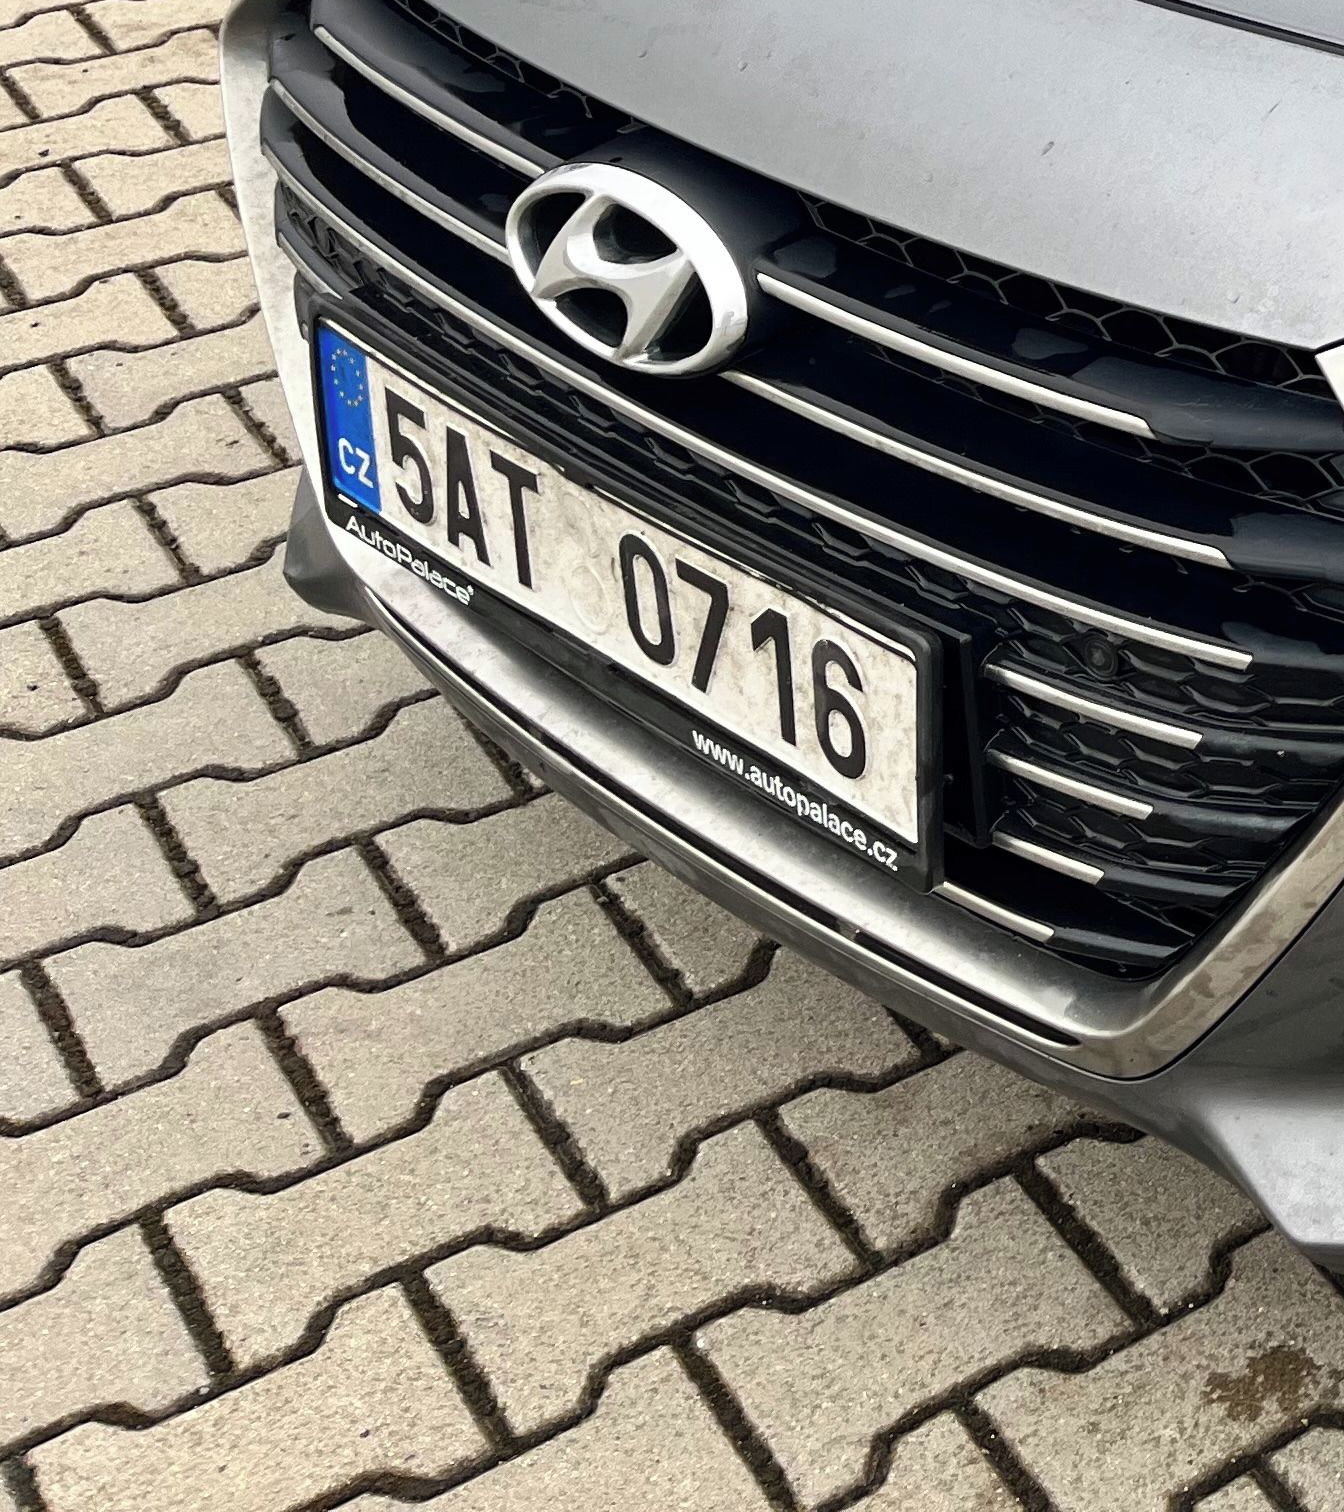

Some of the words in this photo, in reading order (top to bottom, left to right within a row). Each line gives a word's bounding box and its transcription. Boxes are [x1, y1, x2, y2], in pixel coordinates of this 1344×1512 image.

[338, 437, 374, 489] CZ
[384, 386, 540, 589] 5AT
[618, 531, 867, 780] 0716
[691, 729, 899, 872] www.autopalace.cz
